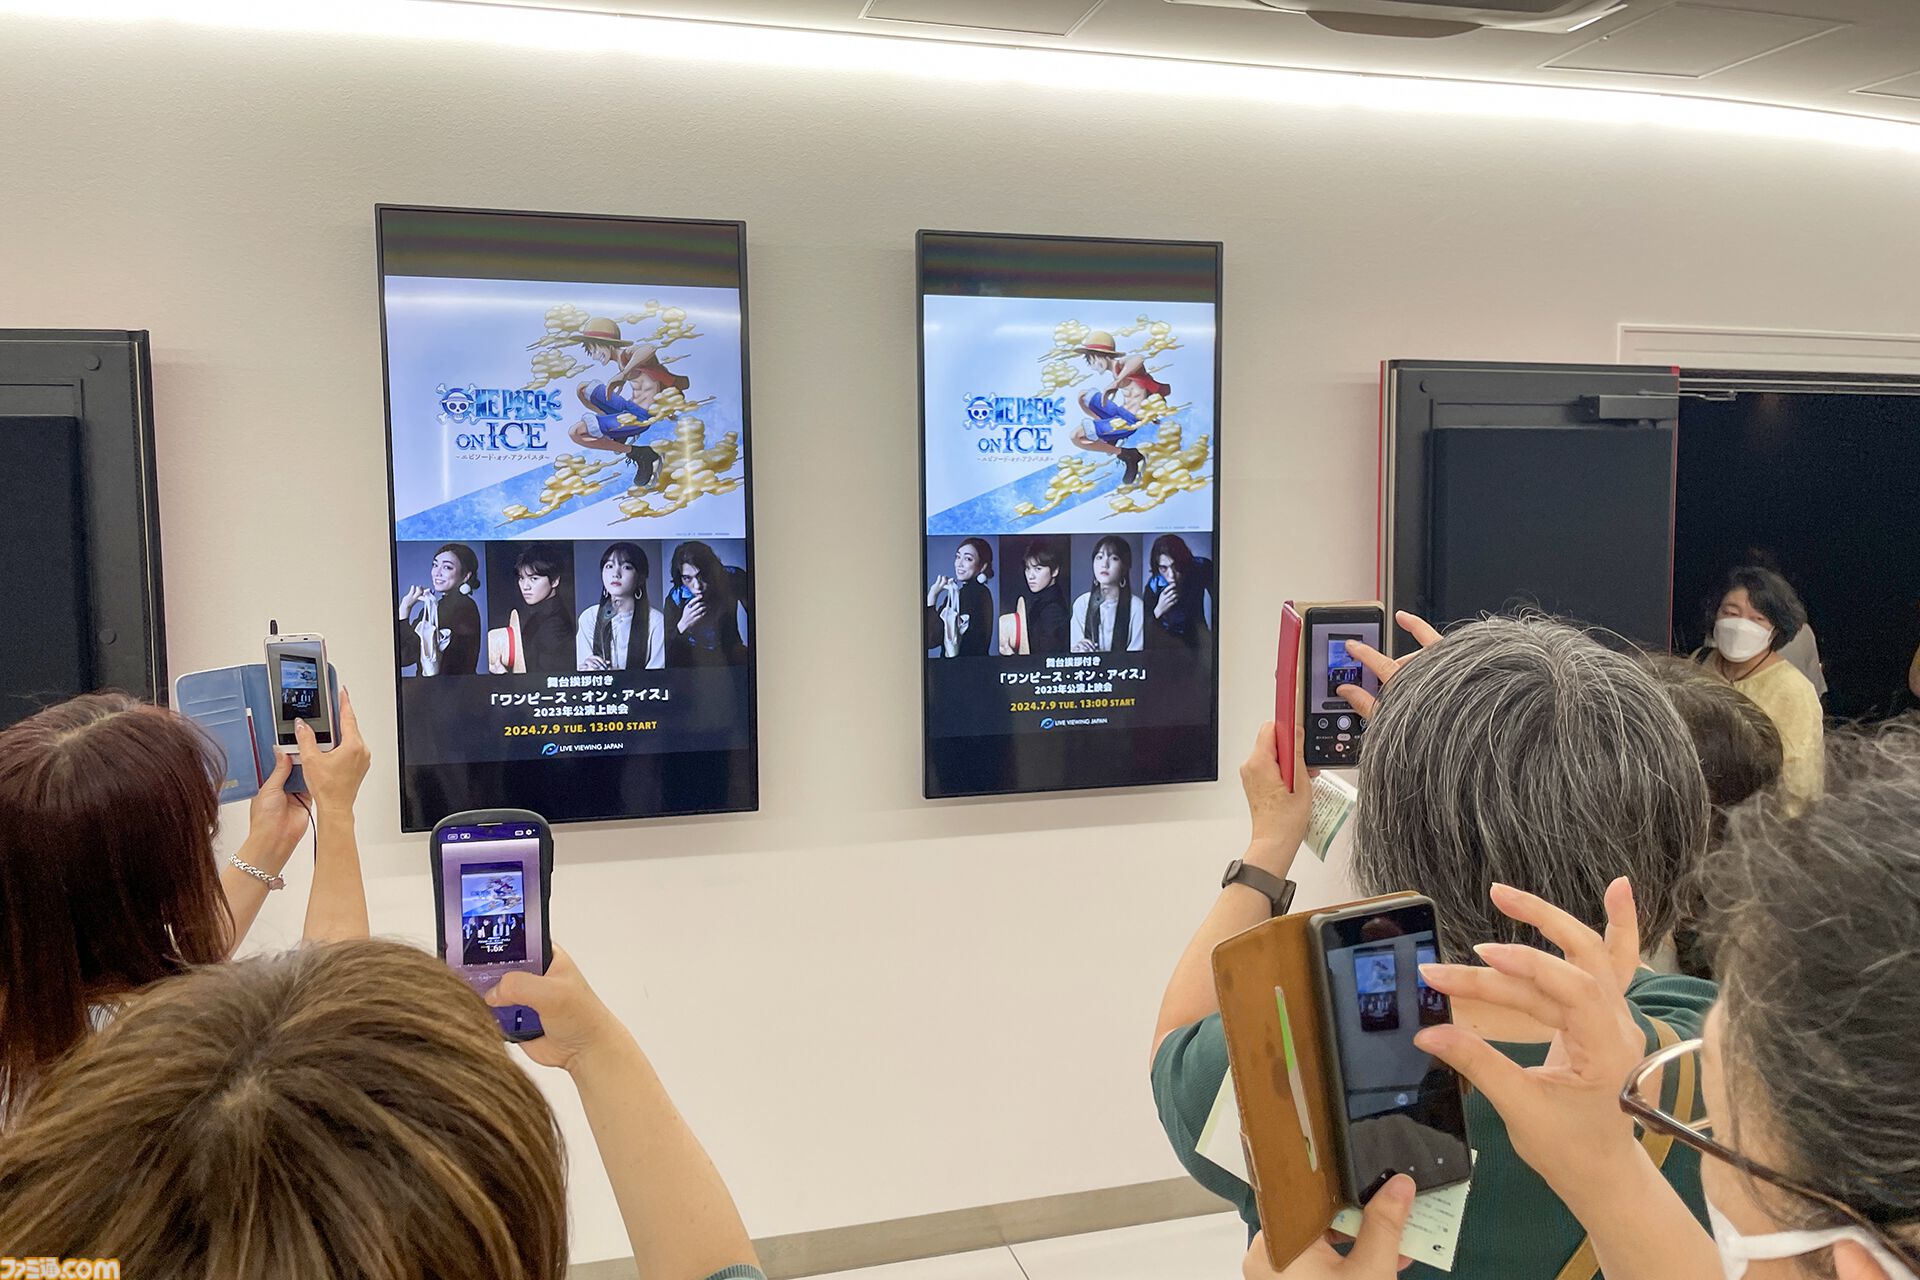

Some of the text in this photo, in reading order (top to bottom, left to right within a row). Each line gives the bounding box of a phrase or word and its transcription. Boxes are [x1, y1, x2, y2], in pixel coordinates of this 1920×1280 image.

[499, 389, 562, 421] PIECE
[456, 422, 548, 451] ON ICE
[978, 428, 1053, 454] ON ICE
[547, 675, 614, 688] 舞台挨拶付き
[1034, 683, 1113, 695] 2023年公演上映会
[490, 689, 669, 706] 「ワンピース・オン・アイス」
[1010, 698, 1136, 712] 2024.7.9 TUE. 13:00 START
[533, 704, 629, 718] 2023年公演上映会
[504, 721, 657, 737] 2024.7.9 TUE. 13:00 START
[559, 743, 624, 752] LIVE VIEWING JAPAN
